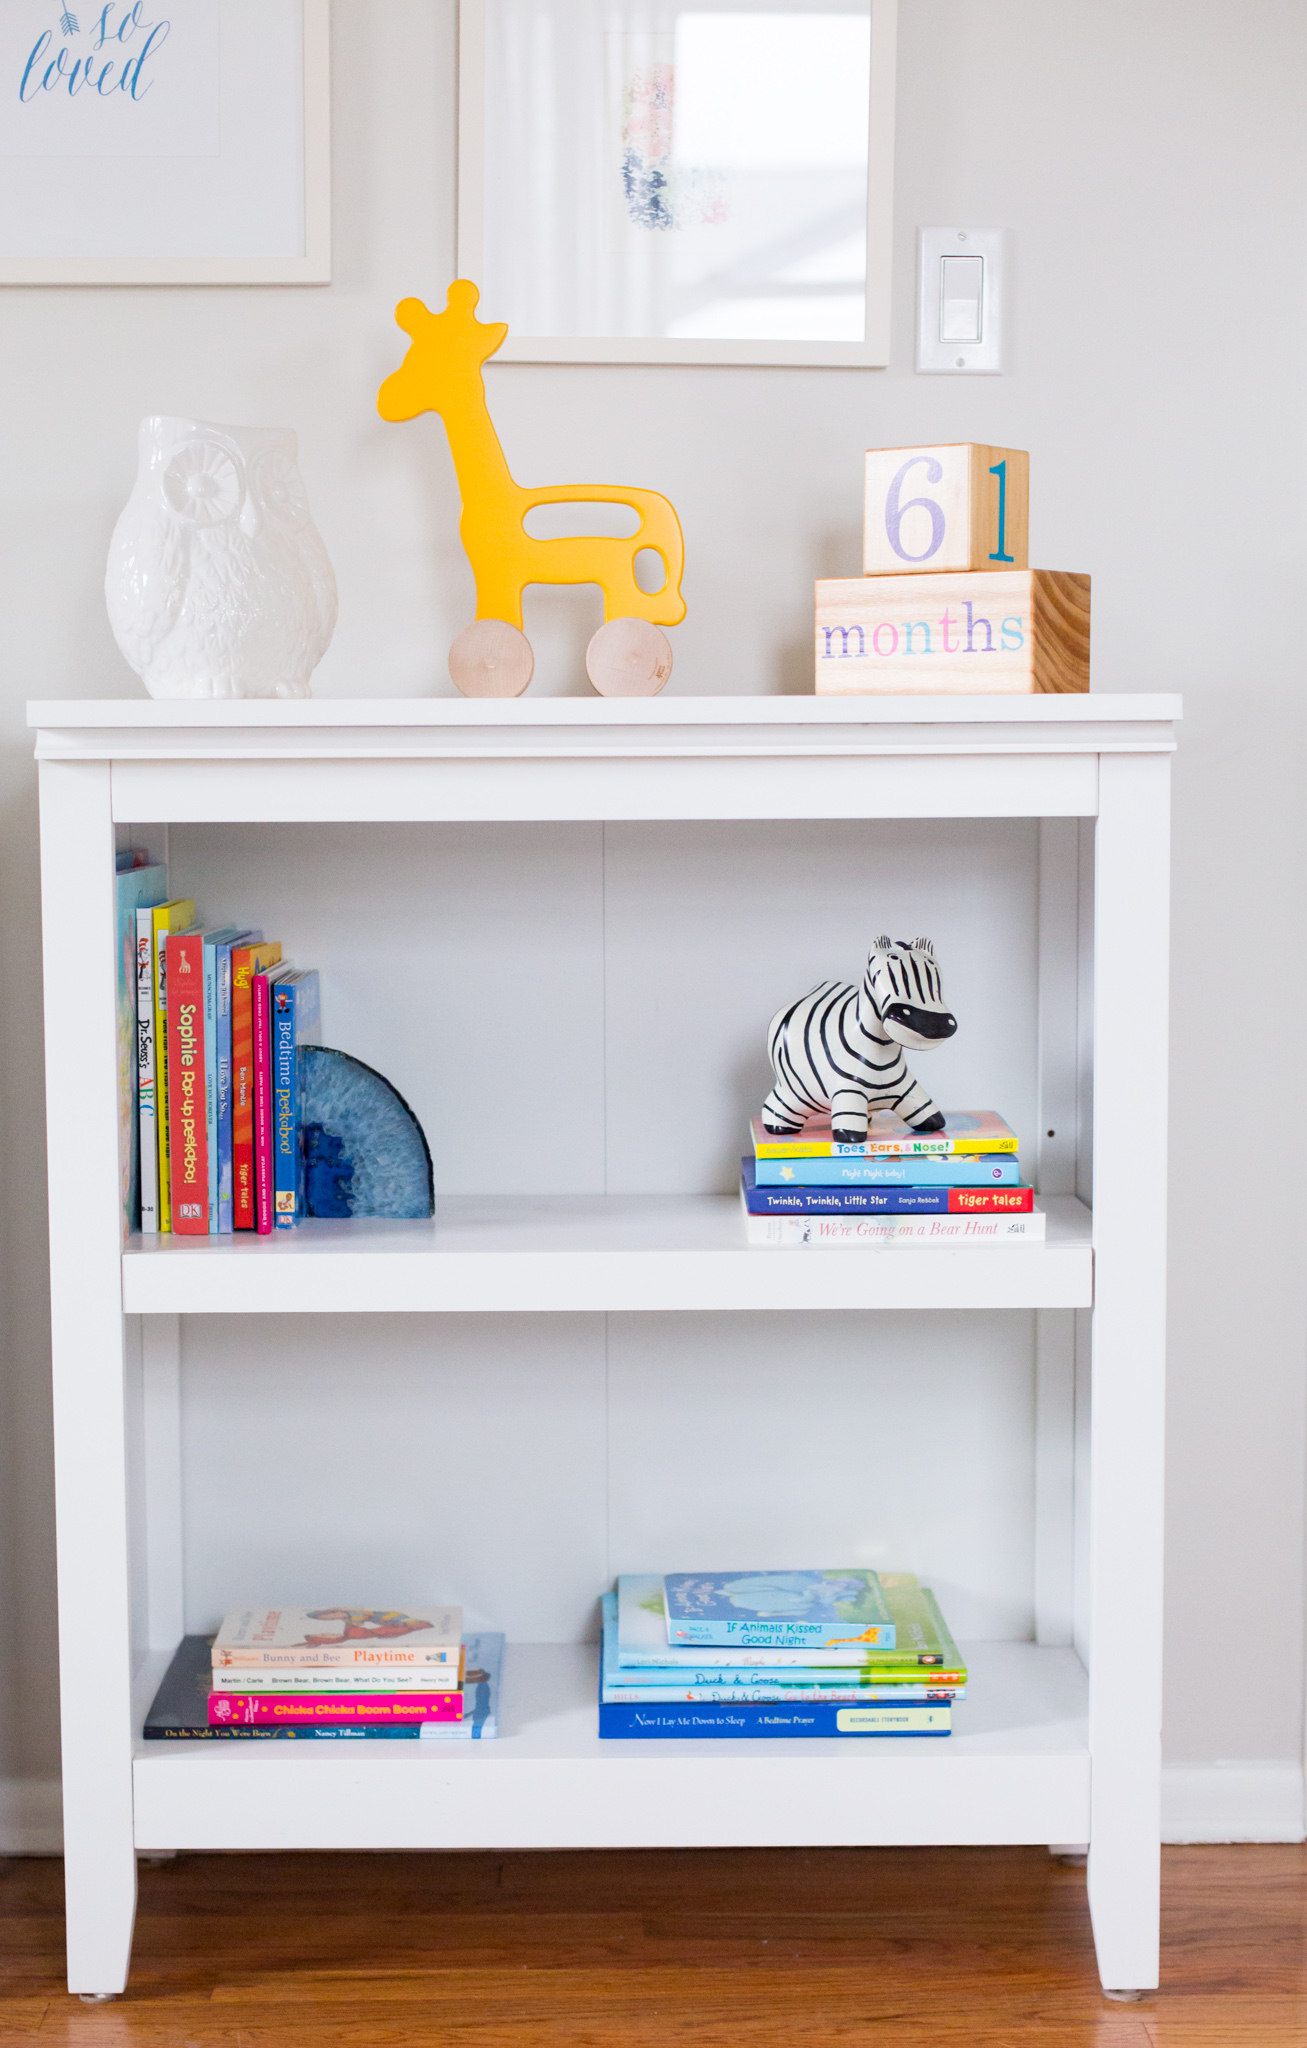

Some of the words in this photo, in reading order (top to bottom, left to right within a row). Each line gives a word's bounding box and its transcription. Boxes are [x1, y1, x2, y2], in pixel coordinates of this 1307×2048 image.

[90, 0, 153, 51] so
[19, 21, 170, 103] loved
[884, 455, 946, 563] 6
[988, 459, 1015, 563] 1
[821, 600, 1025, 659] months
[233, 966, 250, 989] Hug!
[138, 1019, 150, 1035] Dr.
[176, 1004, 198, 1067] Sophie
[278, 1021, 293, 1085] Bedtime
[220, 1065, 228, 1084] Love
[239, 1067, 247, 1081] Ben
[180, 1071, 195, 1116] pop-up
[220, 1086, 228, 1100] You
[276, 1088, 293, 1154] peekaboo!
[180, 1119, 197, 1184] peekaboo!
[836, 1144, 869, 1154] Toes,
[870, 1142, 904, 1153] Ears,
[904, 1143, 911, 1152] &
[913, 1141, 949, 1152] Nose!
[239, 1163, 249, 1186] tiger
[240, 1187, 249, 1209] tales
[767, 1196, 803, 1207] Twinkle,
[806, 1196, 841, 1207] Twinkle,
[844, 1195, 867, 1205] Little
[870, 1196, 888, 1205] Star
[898, 1197, 916, 1205] Sanja
[958, 1194, 990, 1207] tiger
[992, 1194, 1022, 1206] tales
[181, 1204, 200, 1216] DK
[278, 1215, 293, 1224] DK
[819, 1223, 852, 1236] We're
[856, 1222, 896, 1240] Going
[898, 1226, 914, 1235] on
[917, 1226, 925, 1235] a
[929, 1221, 961, 1235] Bear
[963, 1221, 998, 1235] Hunt
[739, 1622, 783, 1633] Animals
[786, 1623, 823, 1634] Kissed
[741, 1635, 772, 1645] Good
[775, 1635, 807, 1646] Night
[263, 1653, 296, 1666] Bunny
[300, 1653, 319, 1662] and
[323, 1653, 341, 1662] Bee
[353, 1650, 415, 1665] Playtime
[695, 1673, 726, 1685] Duck
[733, 1674, 744, 1684] &
[751, 1673, 779, 1685] Goose
[712, 1690, 737, 1702] Duck
[752, 1690, 781, 1701] Goose
[784, 1691, 798, 1700] Go
[800, 1691, 810, 1700] to
[812, 1690, 827, 1700] the
[830, 1690, 857, 1700] Beach
[273, 1705, 314, 1715] Chicka
[315, 1704, 356, 1715] Chicka
[356, 1704, 391, 1715] Boom
[392, 1704, 427, 1715] Boom
[629, 1713, 656, 1727] Now
[662, 1717, 676, 1728] Lay
[676, 1716, 690, 1725] Me
[692, 1717, 715, 1725] Down
[717, 1717, 725, 1725] to
[725, 1716, 746, 1727] Sleep
[764, 1716, 792, 1724] Bedtime
[793, 1716, 815, 1727] Prayer
[165, 1729, 178, 1737] On
[178, 1729, 190, 1737] the
[190, 1729, 213, 1738] Night
[215, 1729, 230, 1737] You
[231, 1729, 251, 1737] Were
[252, 1728, 271, 1737] Born
[314, 1729, 337, 1738] Nancy
[338, 1728, 366, 1737] Tillman
